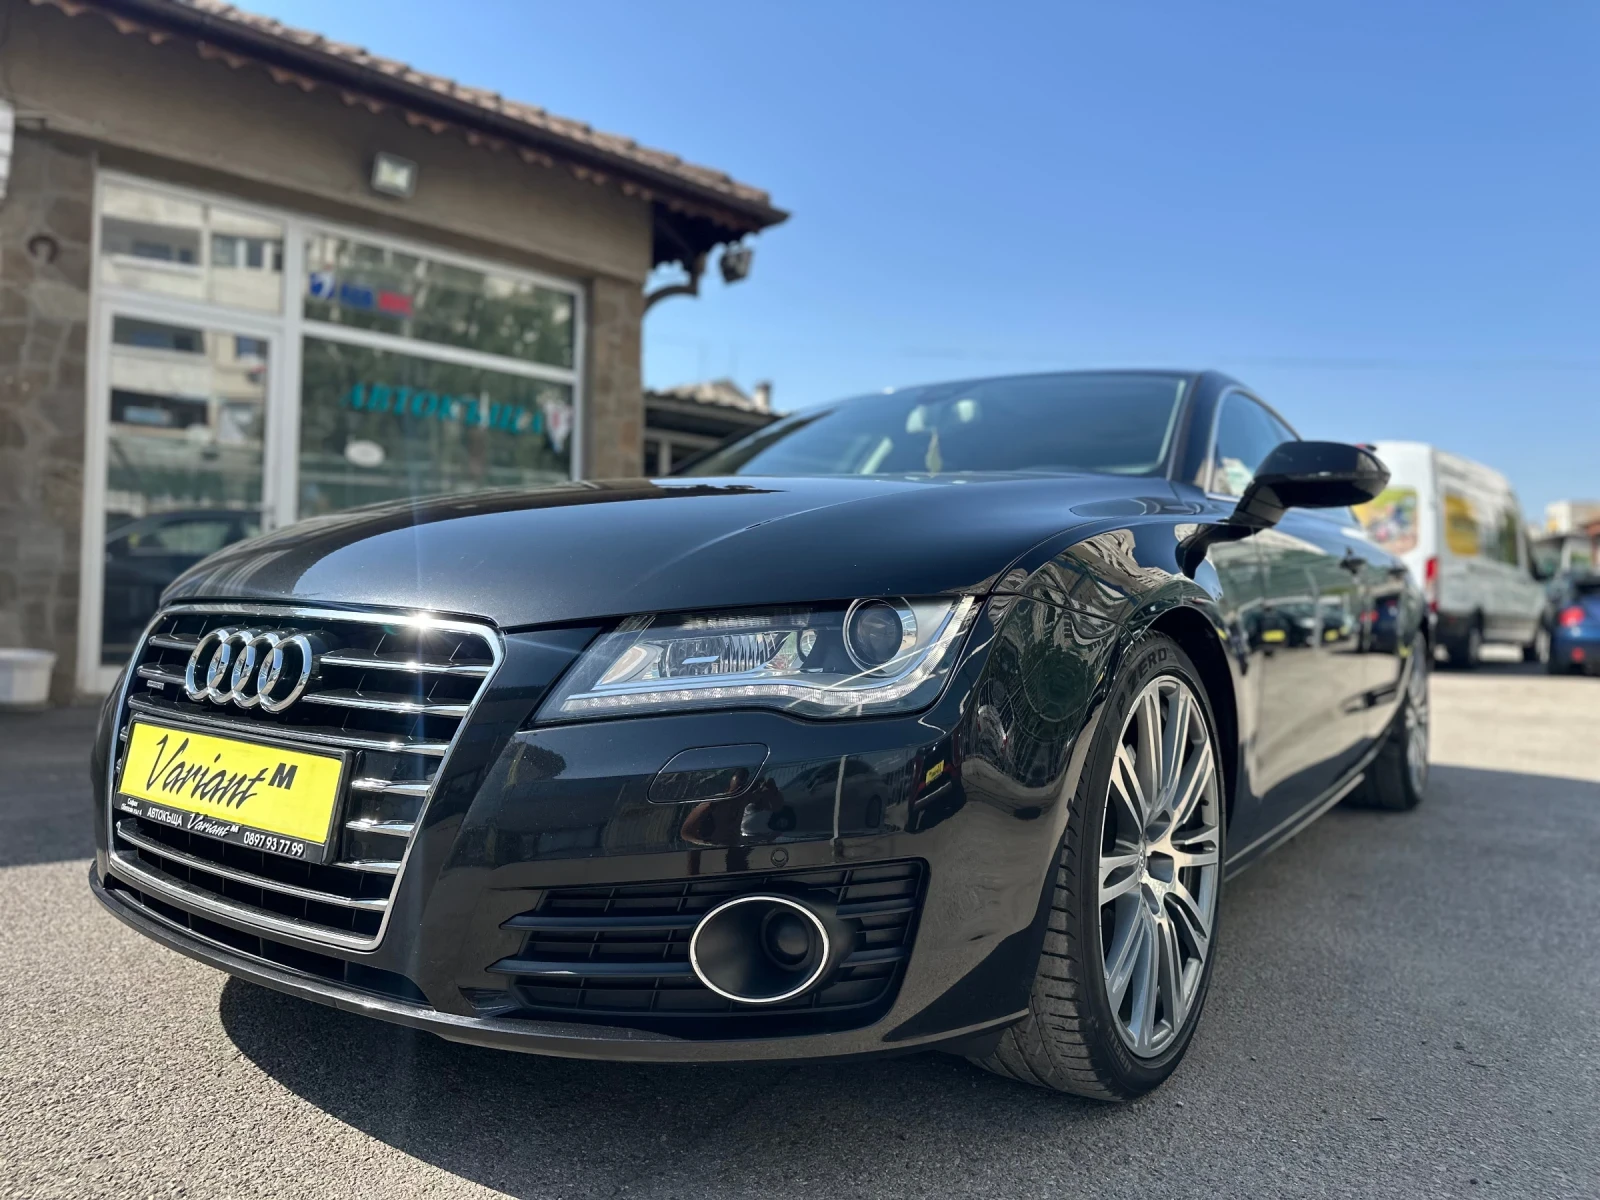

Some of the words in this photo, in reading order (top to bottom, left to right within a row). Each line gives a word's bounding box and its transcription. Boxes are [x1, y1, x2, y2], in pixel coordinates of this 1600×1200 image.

[146, 734, 269, 810] Variant
[267, 762, 299, 790] M
[146, 806, 183, 827] АВТОКЪЩА
[187, 813, 231, 837] Variant
[243, 831, 266, 848] 0897
[266, 836, 278, 851] 93
[279, 839, 291, 853] 77
[291, 842, 304, 856] 99
